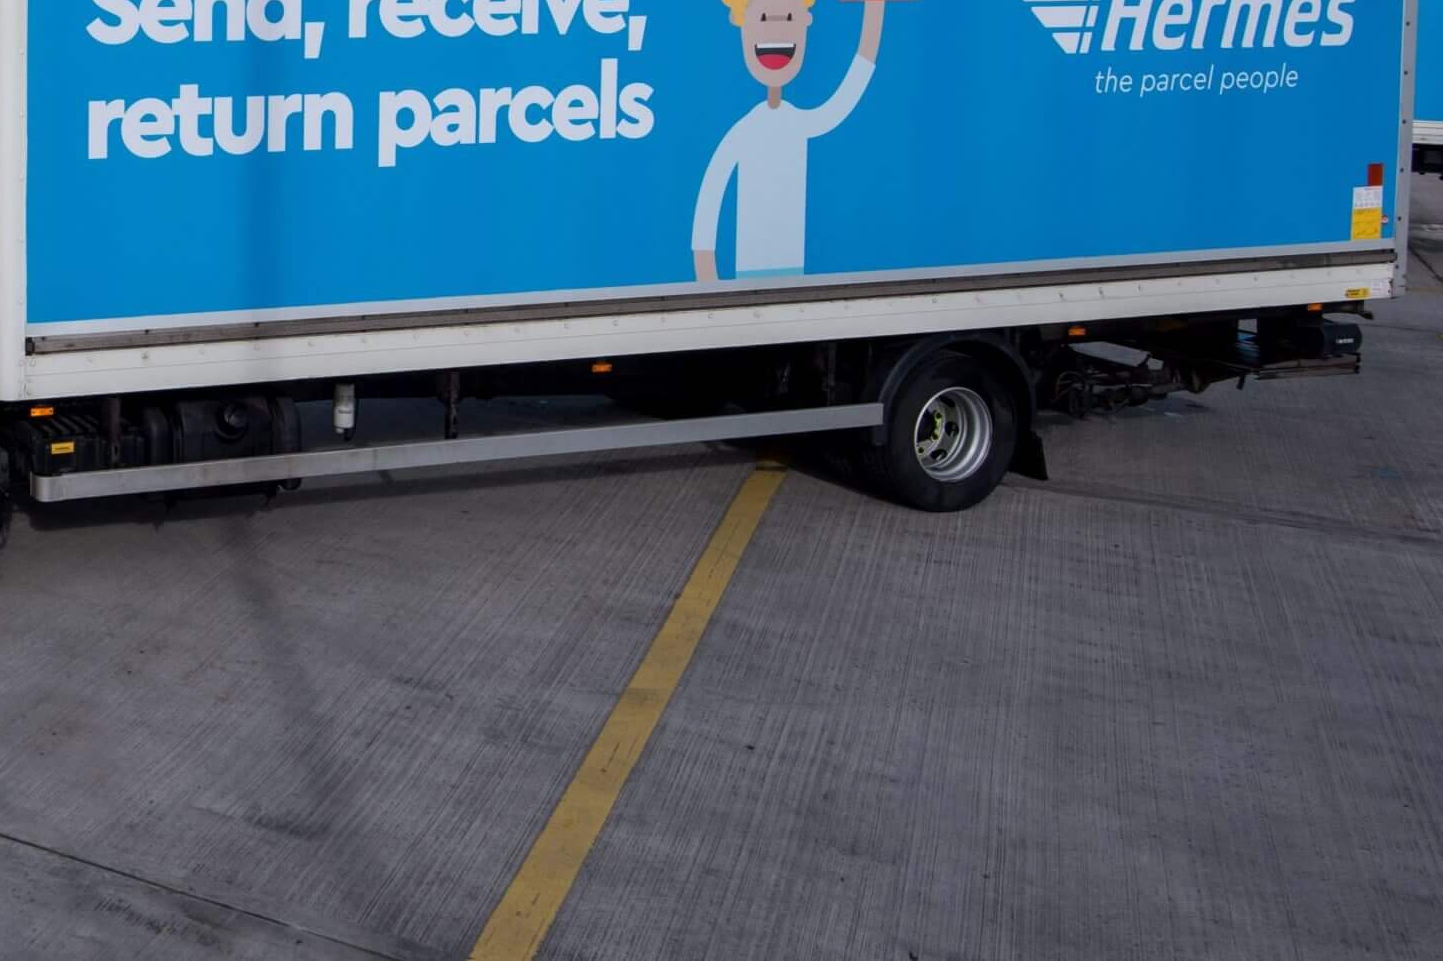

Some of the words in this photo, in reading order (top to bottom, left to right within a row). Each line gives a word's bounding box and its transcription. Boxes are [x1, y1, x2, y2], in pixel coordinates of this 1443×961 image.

[88, 84, 353, 159] return
[378, 59, 654, 167] parcels
[1095, 66, 1133, 94] the
[1140, 64, 1214, 98] parcel
[1220, 63, 1298, 95] people
